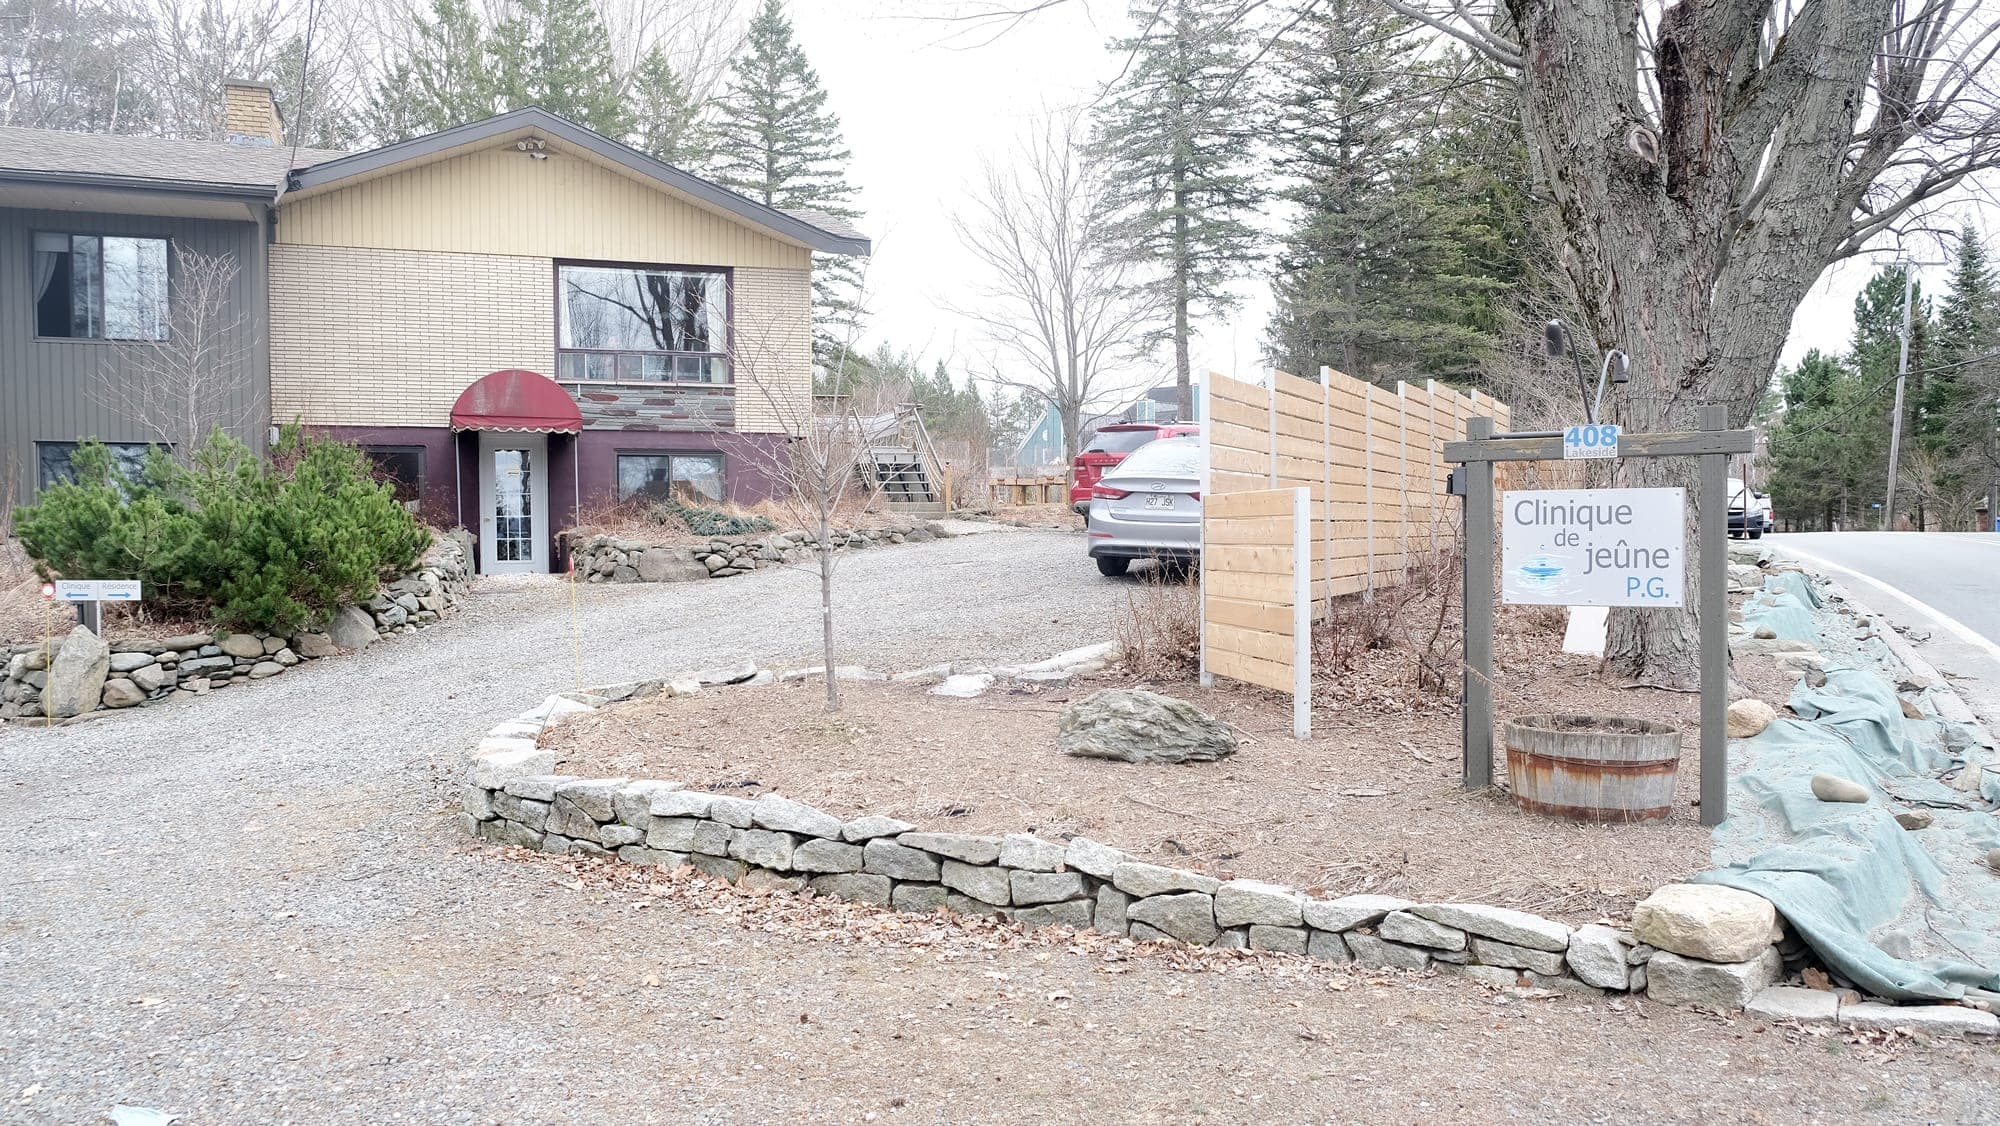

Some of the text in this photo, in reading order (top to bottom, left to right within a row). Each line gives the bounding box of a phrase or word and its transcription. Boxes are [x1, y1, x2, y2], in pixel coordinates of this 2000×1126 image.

[1565, 425, 1617, 447] 408
[1566, 448, 1616, 457] Lakeside
[1514, 499, 1632, 531] Clinique
[1554, 528, 1580, 547] de
[1583, 539, 1670, 574] jeûne
[61, 583, 91, 591] Clinique
[1626, 576, 1669, 598] P.G.
